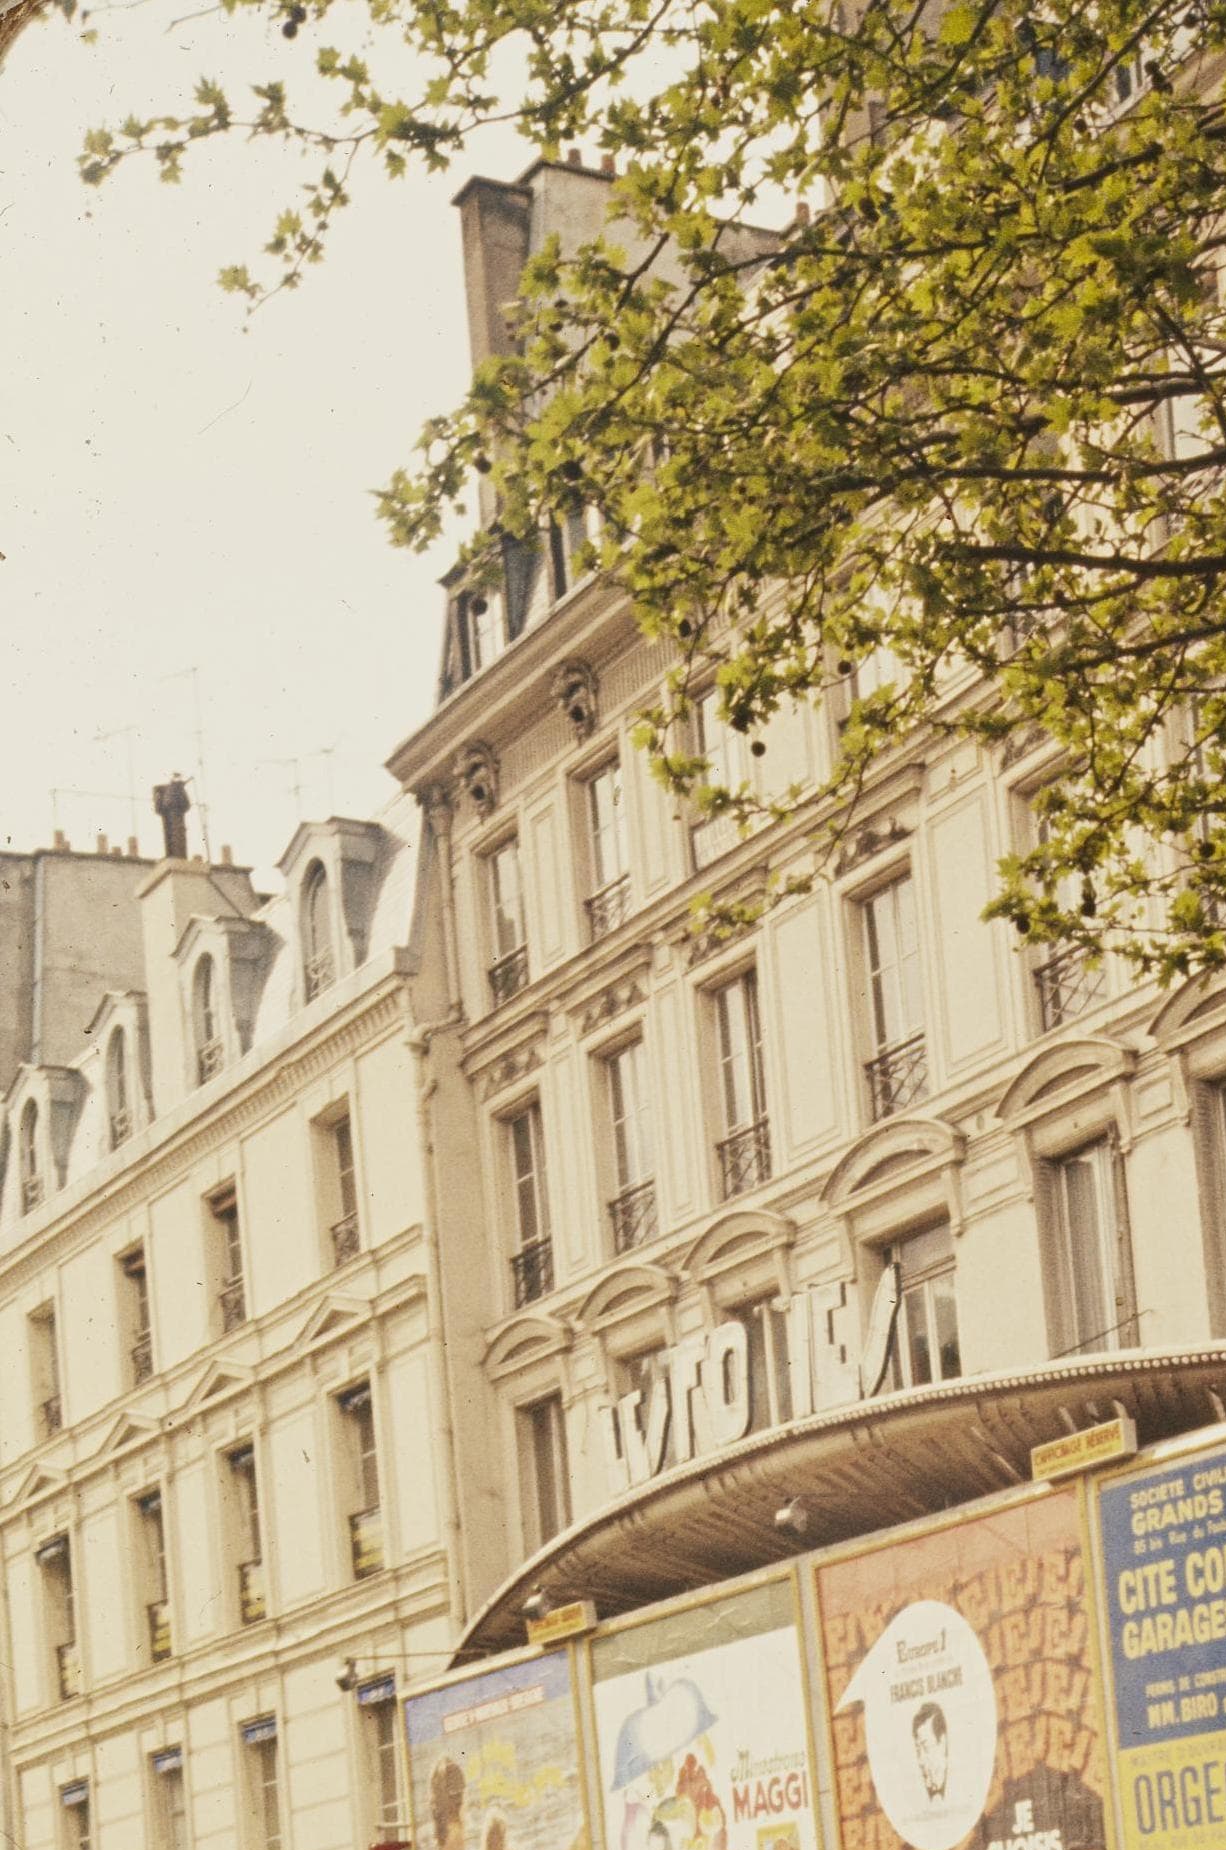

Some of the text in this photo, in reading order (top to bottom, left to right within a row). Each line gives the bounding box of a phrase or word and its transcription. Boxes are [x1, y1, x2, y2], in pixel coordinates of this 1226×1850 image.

[1131, 1488, 1224, 1536] GRANDS
[1119, 1558, 1178, 1615] CITE
[889, 1676, 925, 1703] FRANCIS
[732, 1770, 809, 1824] MAGGI
[1012, 1798, 1035, 1834] JE
